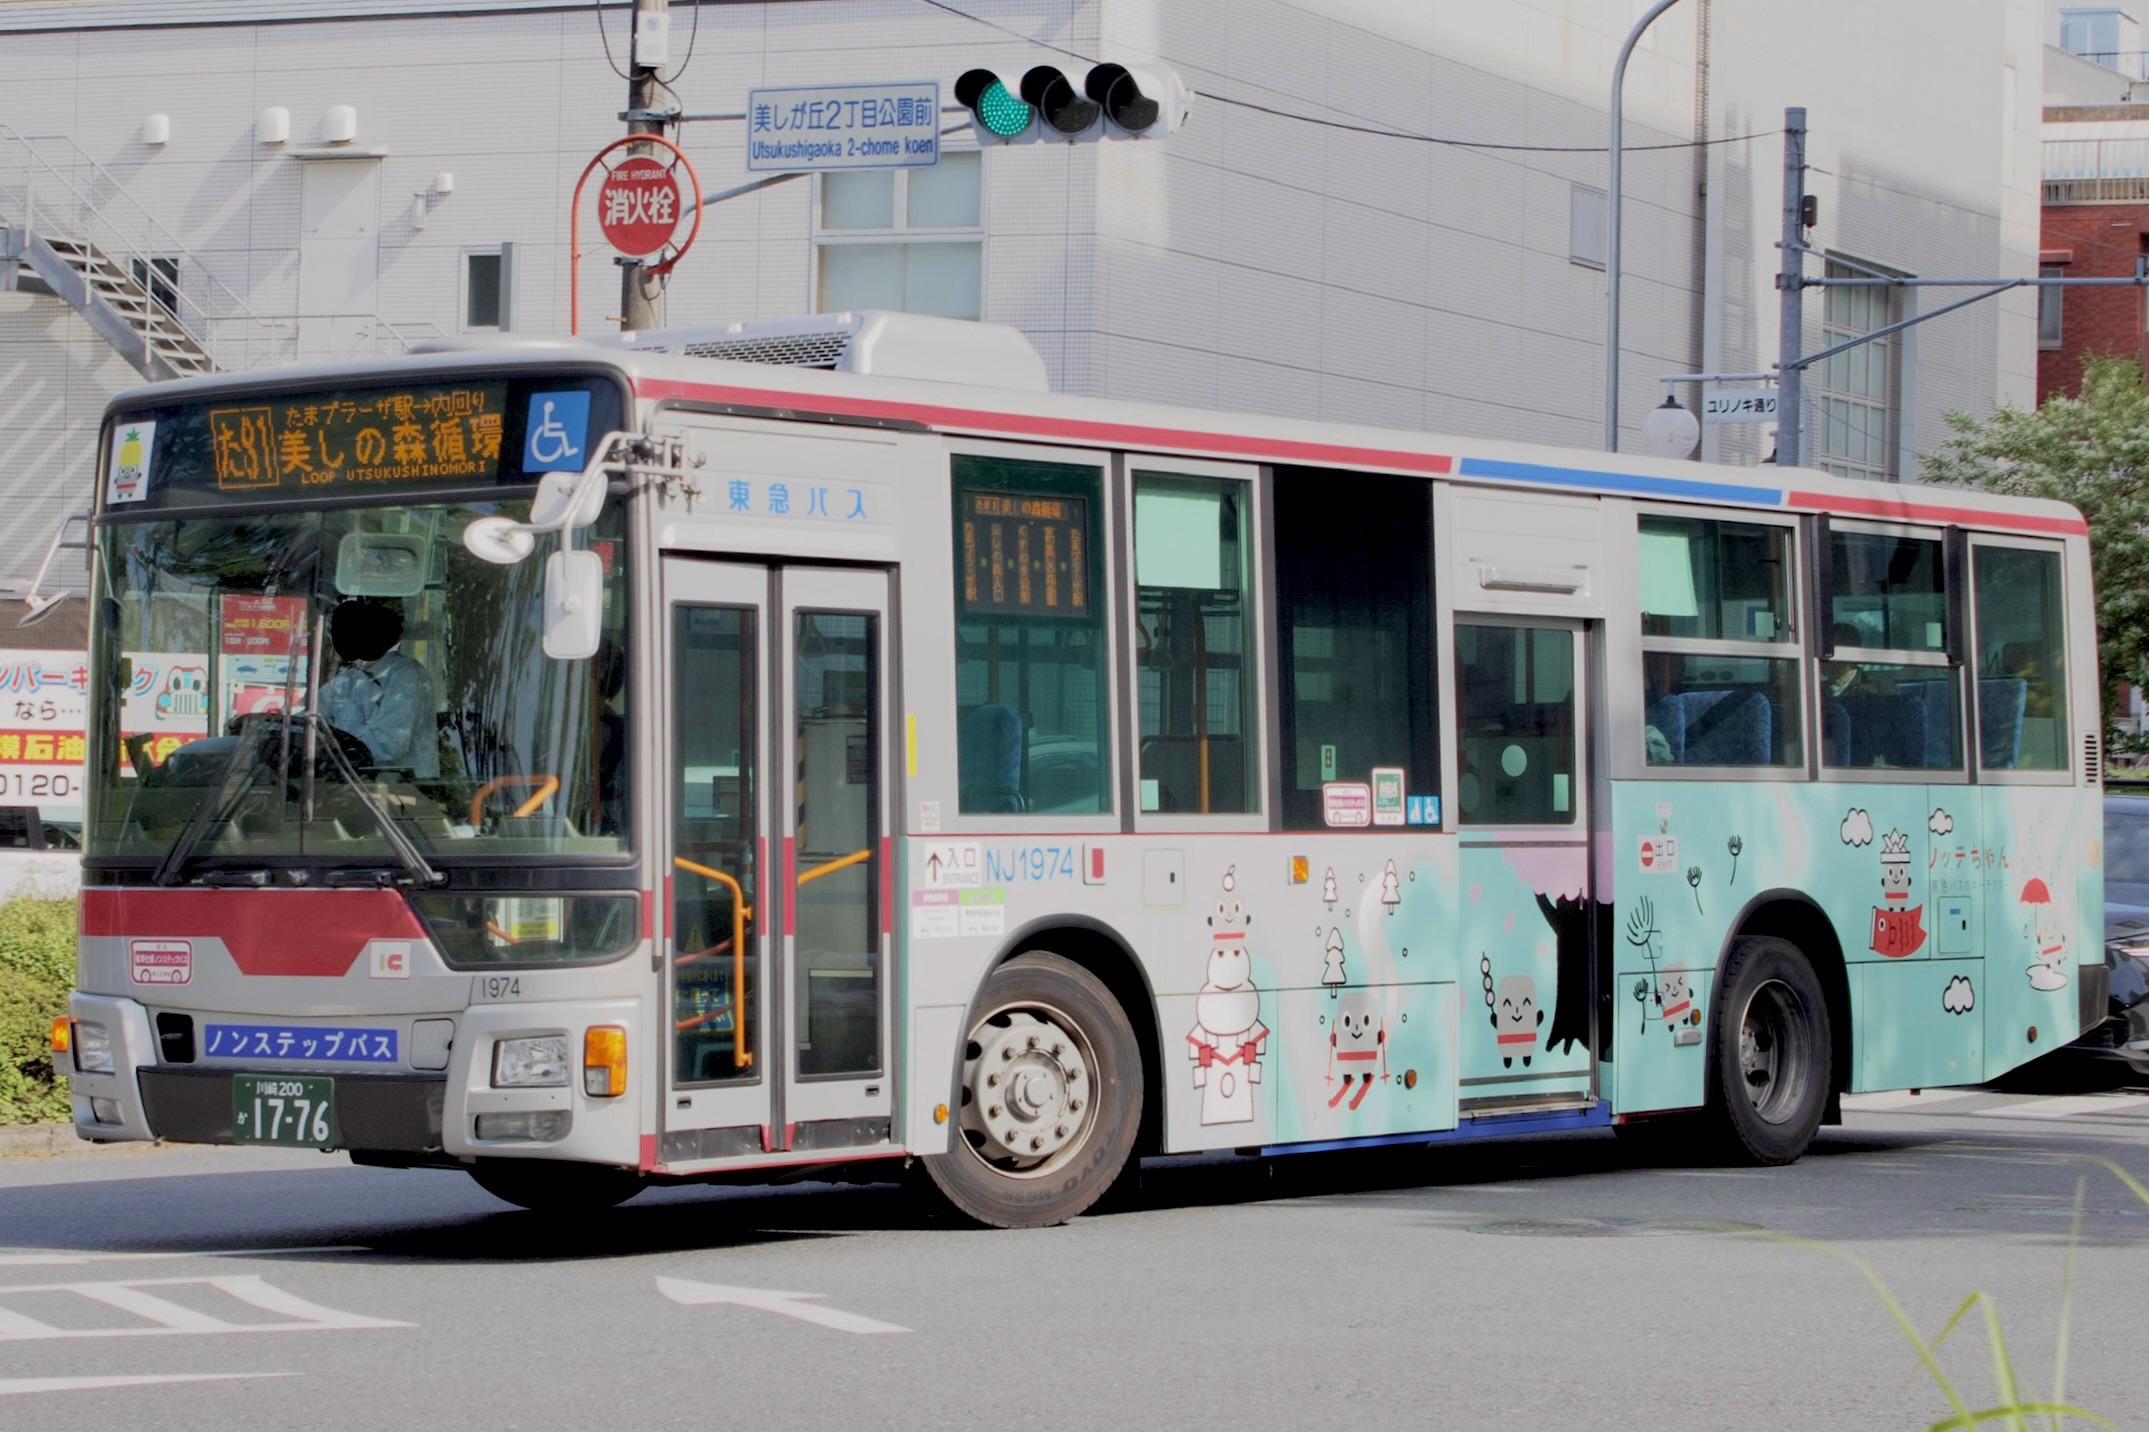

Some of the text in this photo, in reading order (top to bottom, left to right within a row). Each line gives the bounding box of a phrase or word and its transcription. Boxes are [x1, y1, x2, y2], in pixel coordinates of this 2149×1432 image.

[753, 98, 933, 134] 美しが丘2丁目公園前
[752, 136, 933, 161] Utsukushigaoka 2-chome koen
[611, 169, 666, 181] FIRE HYDRANT
[605, 186, 675, 226] 消火栓
[286, 395, 416, 428] たまプラーザ駅
[1707, 398, 1777, 414] ユリノキ通り
[279, 413, 503, 474] 美しの森循環
[301, 461, 486, 485] LOOP UTSUKUSHINOMORI
[728, 479, 868, 519] 東急バス
[946, 848, 976, 868] 入口
[1655, 839, 1675, 857] 出口
[1929, 844, 2010, 870] ノッテちゃん
[986, 847, 1073, 882] NJ1974
[481, 976, 521, 999] 1974
[208, 1030, 393, 1060] ノンステップバス
[254, 1098, 330, 1142] 17-76
